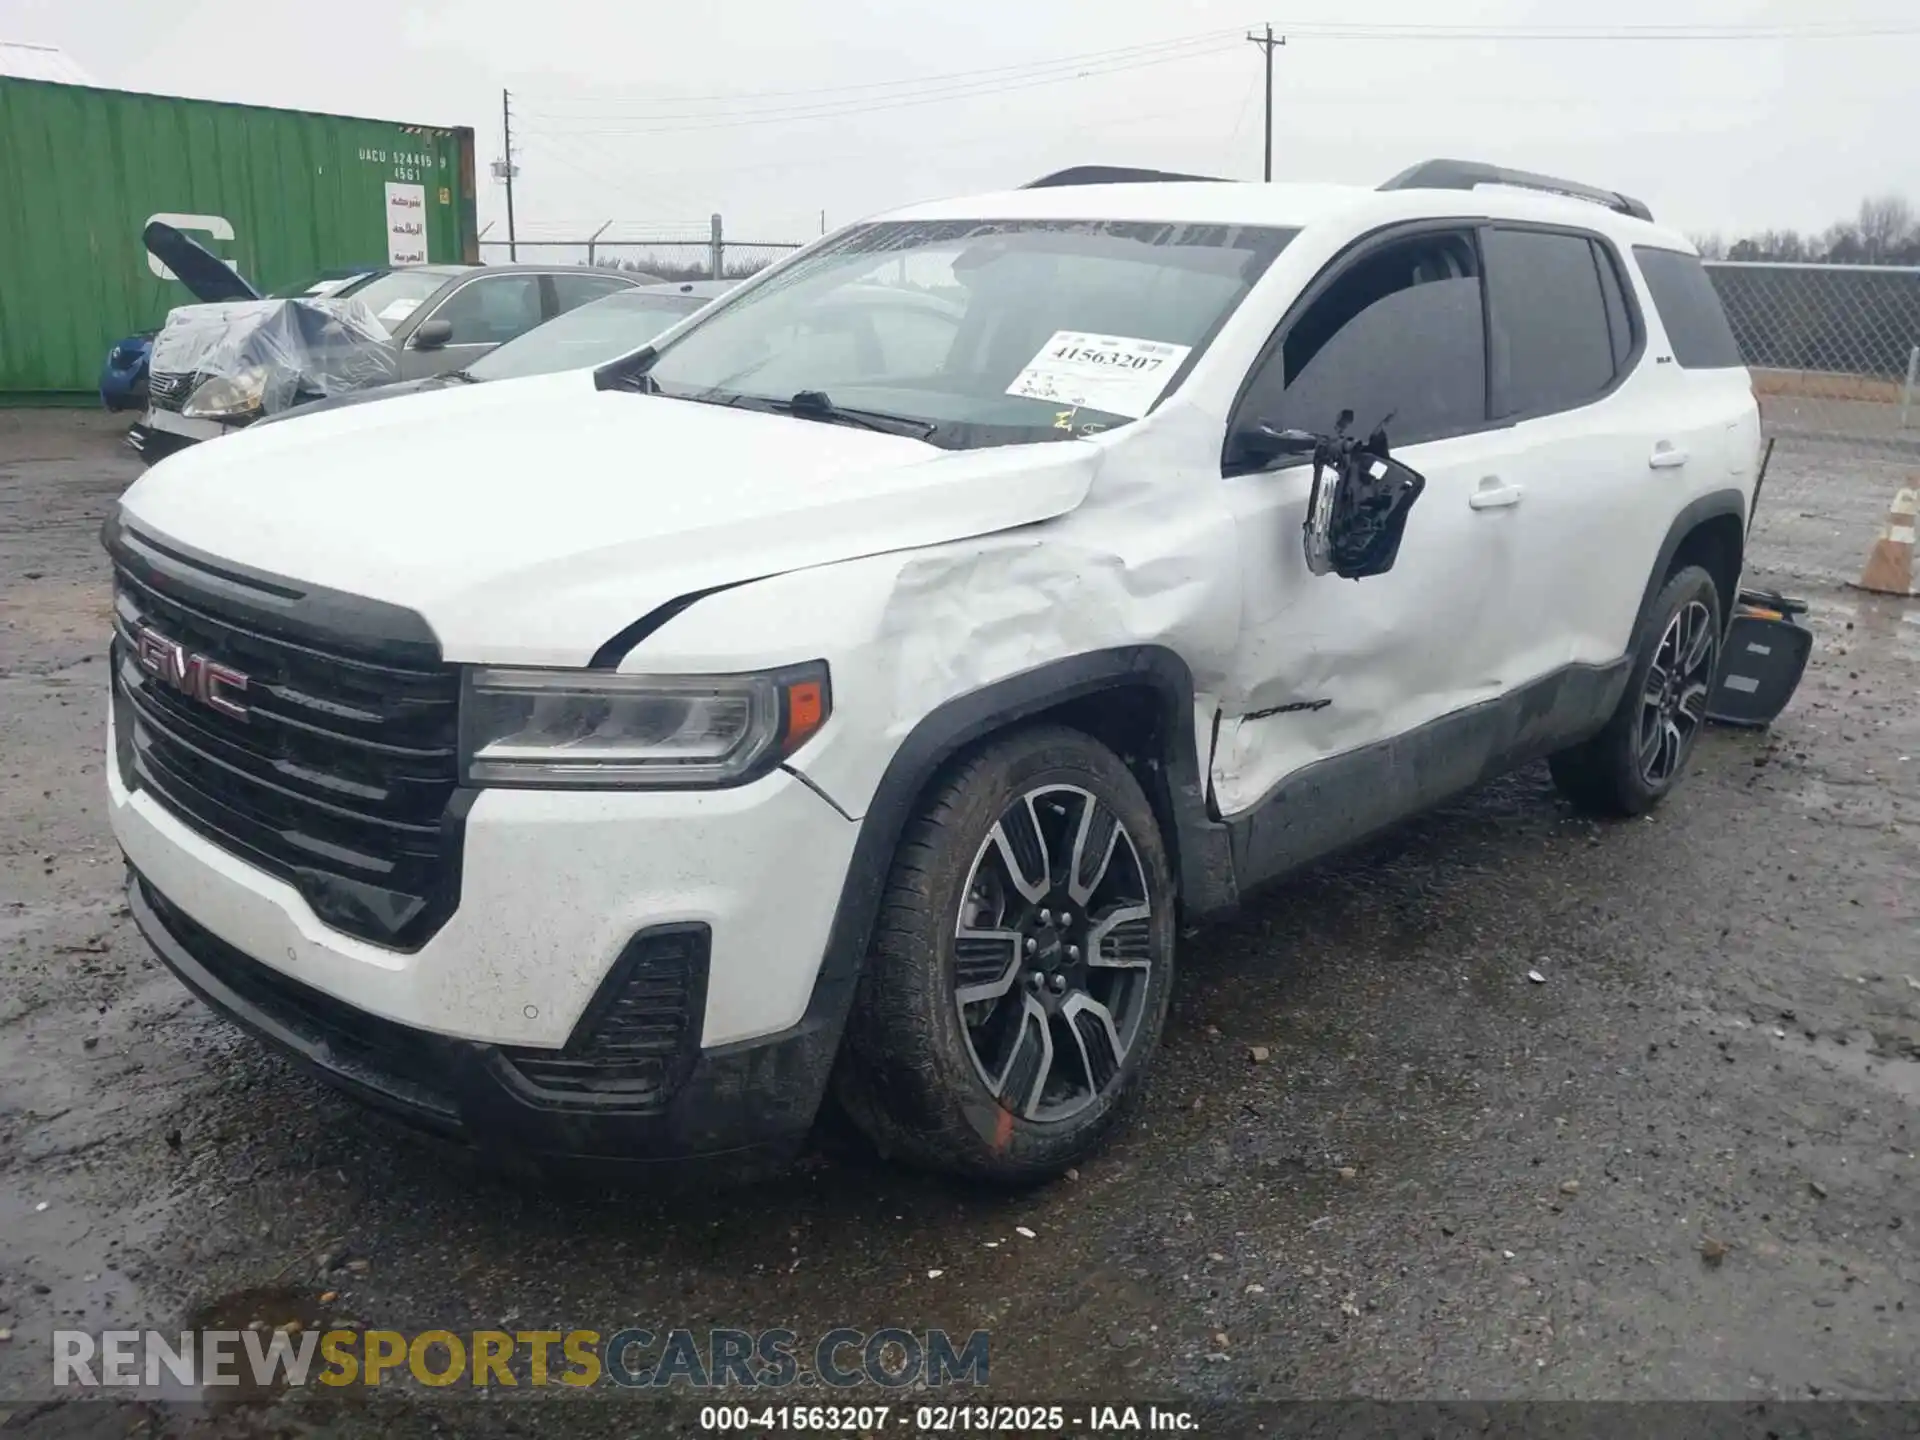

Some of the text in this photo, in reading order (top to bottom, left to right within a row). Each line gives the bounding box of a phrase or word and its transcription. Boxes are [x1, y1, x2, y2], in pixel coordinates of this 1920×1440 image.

[359, 147, 386, 163] UACU
[1052, 346, 1164, 372] 41563207
[137, 626, 250, 724] GMC
